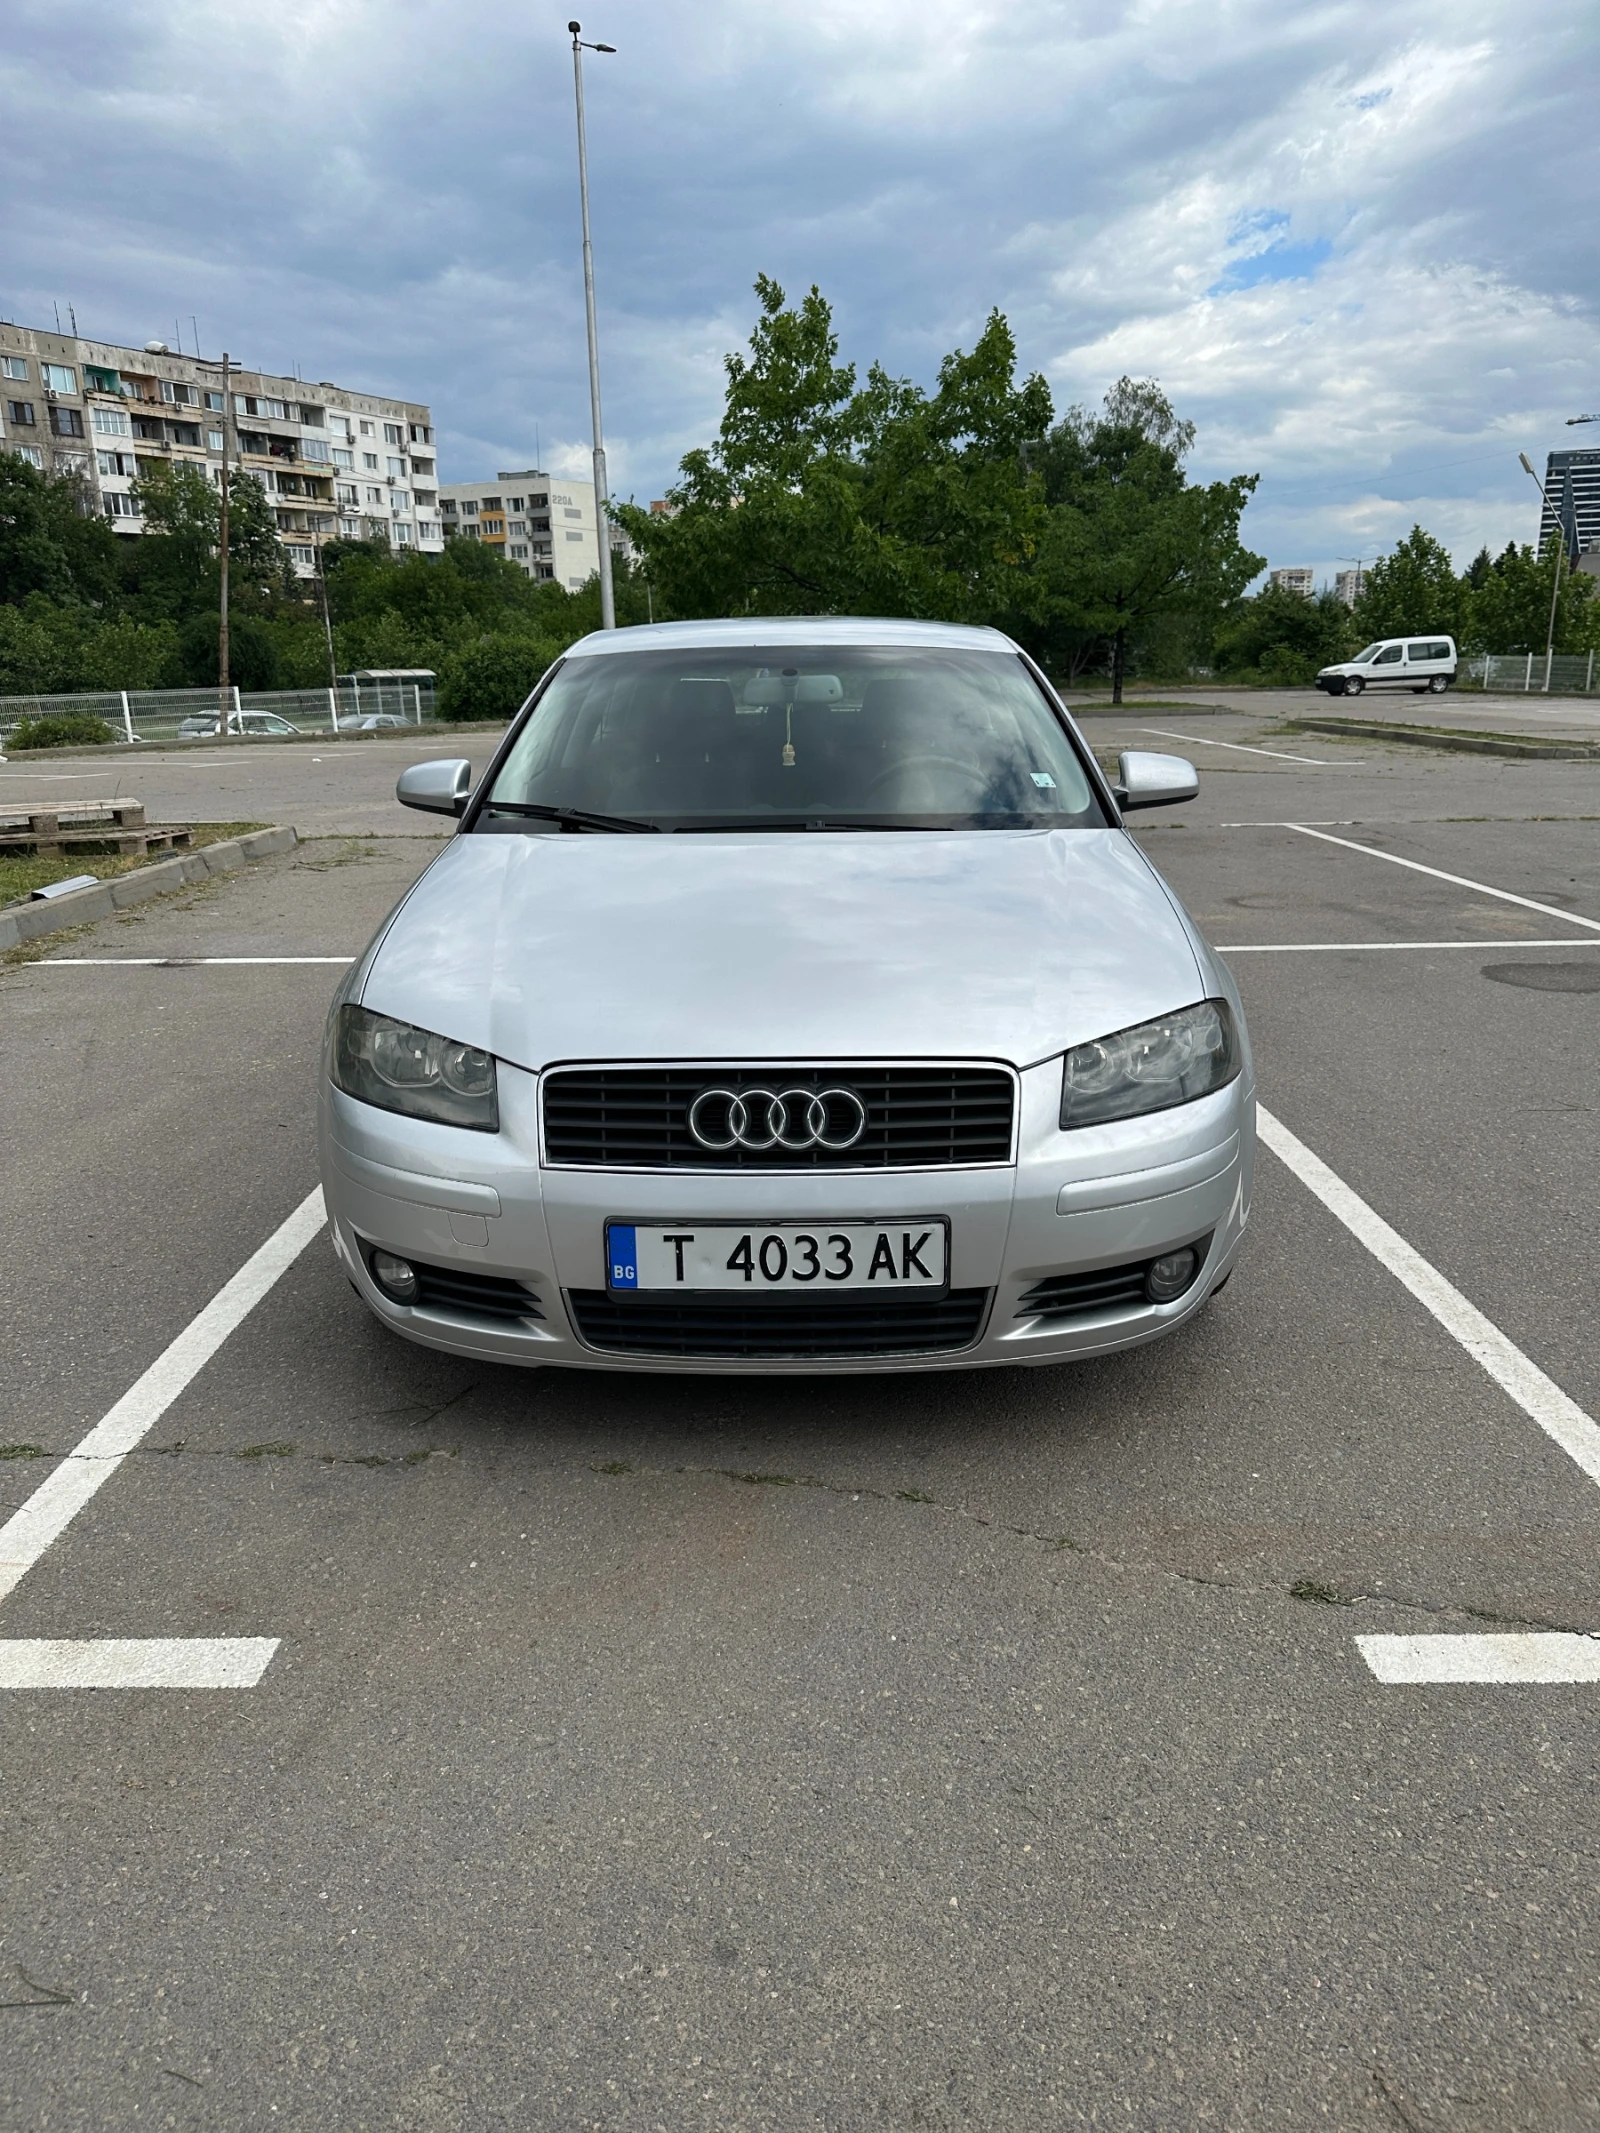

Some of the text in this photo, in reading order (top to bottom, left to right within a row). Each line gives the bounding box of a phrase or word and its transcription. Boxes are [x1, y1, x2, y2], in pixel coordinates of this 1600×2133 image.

[614, 1265, 635, 1280] BG
[663, 1232, 933, 1281] T 4033 AK
